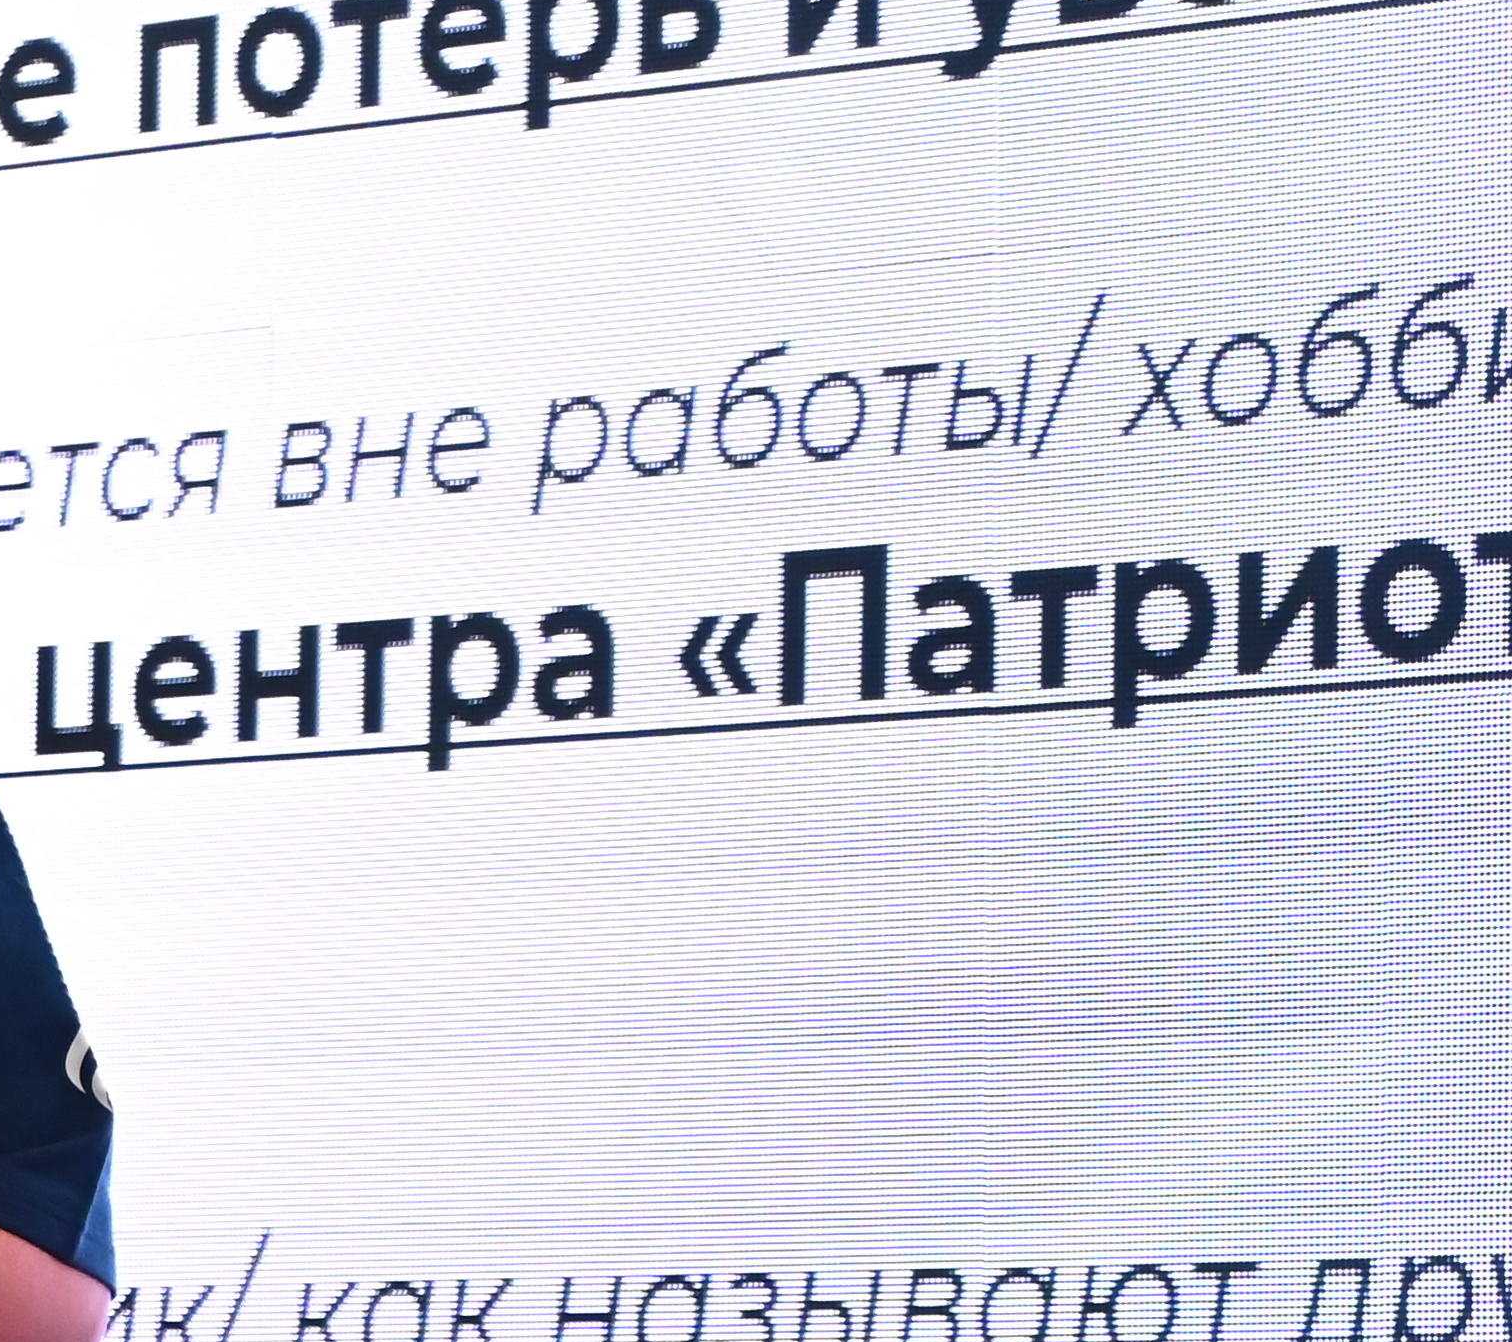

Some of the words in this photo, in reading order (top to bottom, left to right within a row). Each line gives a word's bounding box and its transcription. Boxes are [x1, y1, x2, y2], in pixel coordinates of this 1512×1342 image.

[270, 405, 493, 508] вне
[530, 288, 1106, 515] работы/
[32, 604, 616, 772] центра
